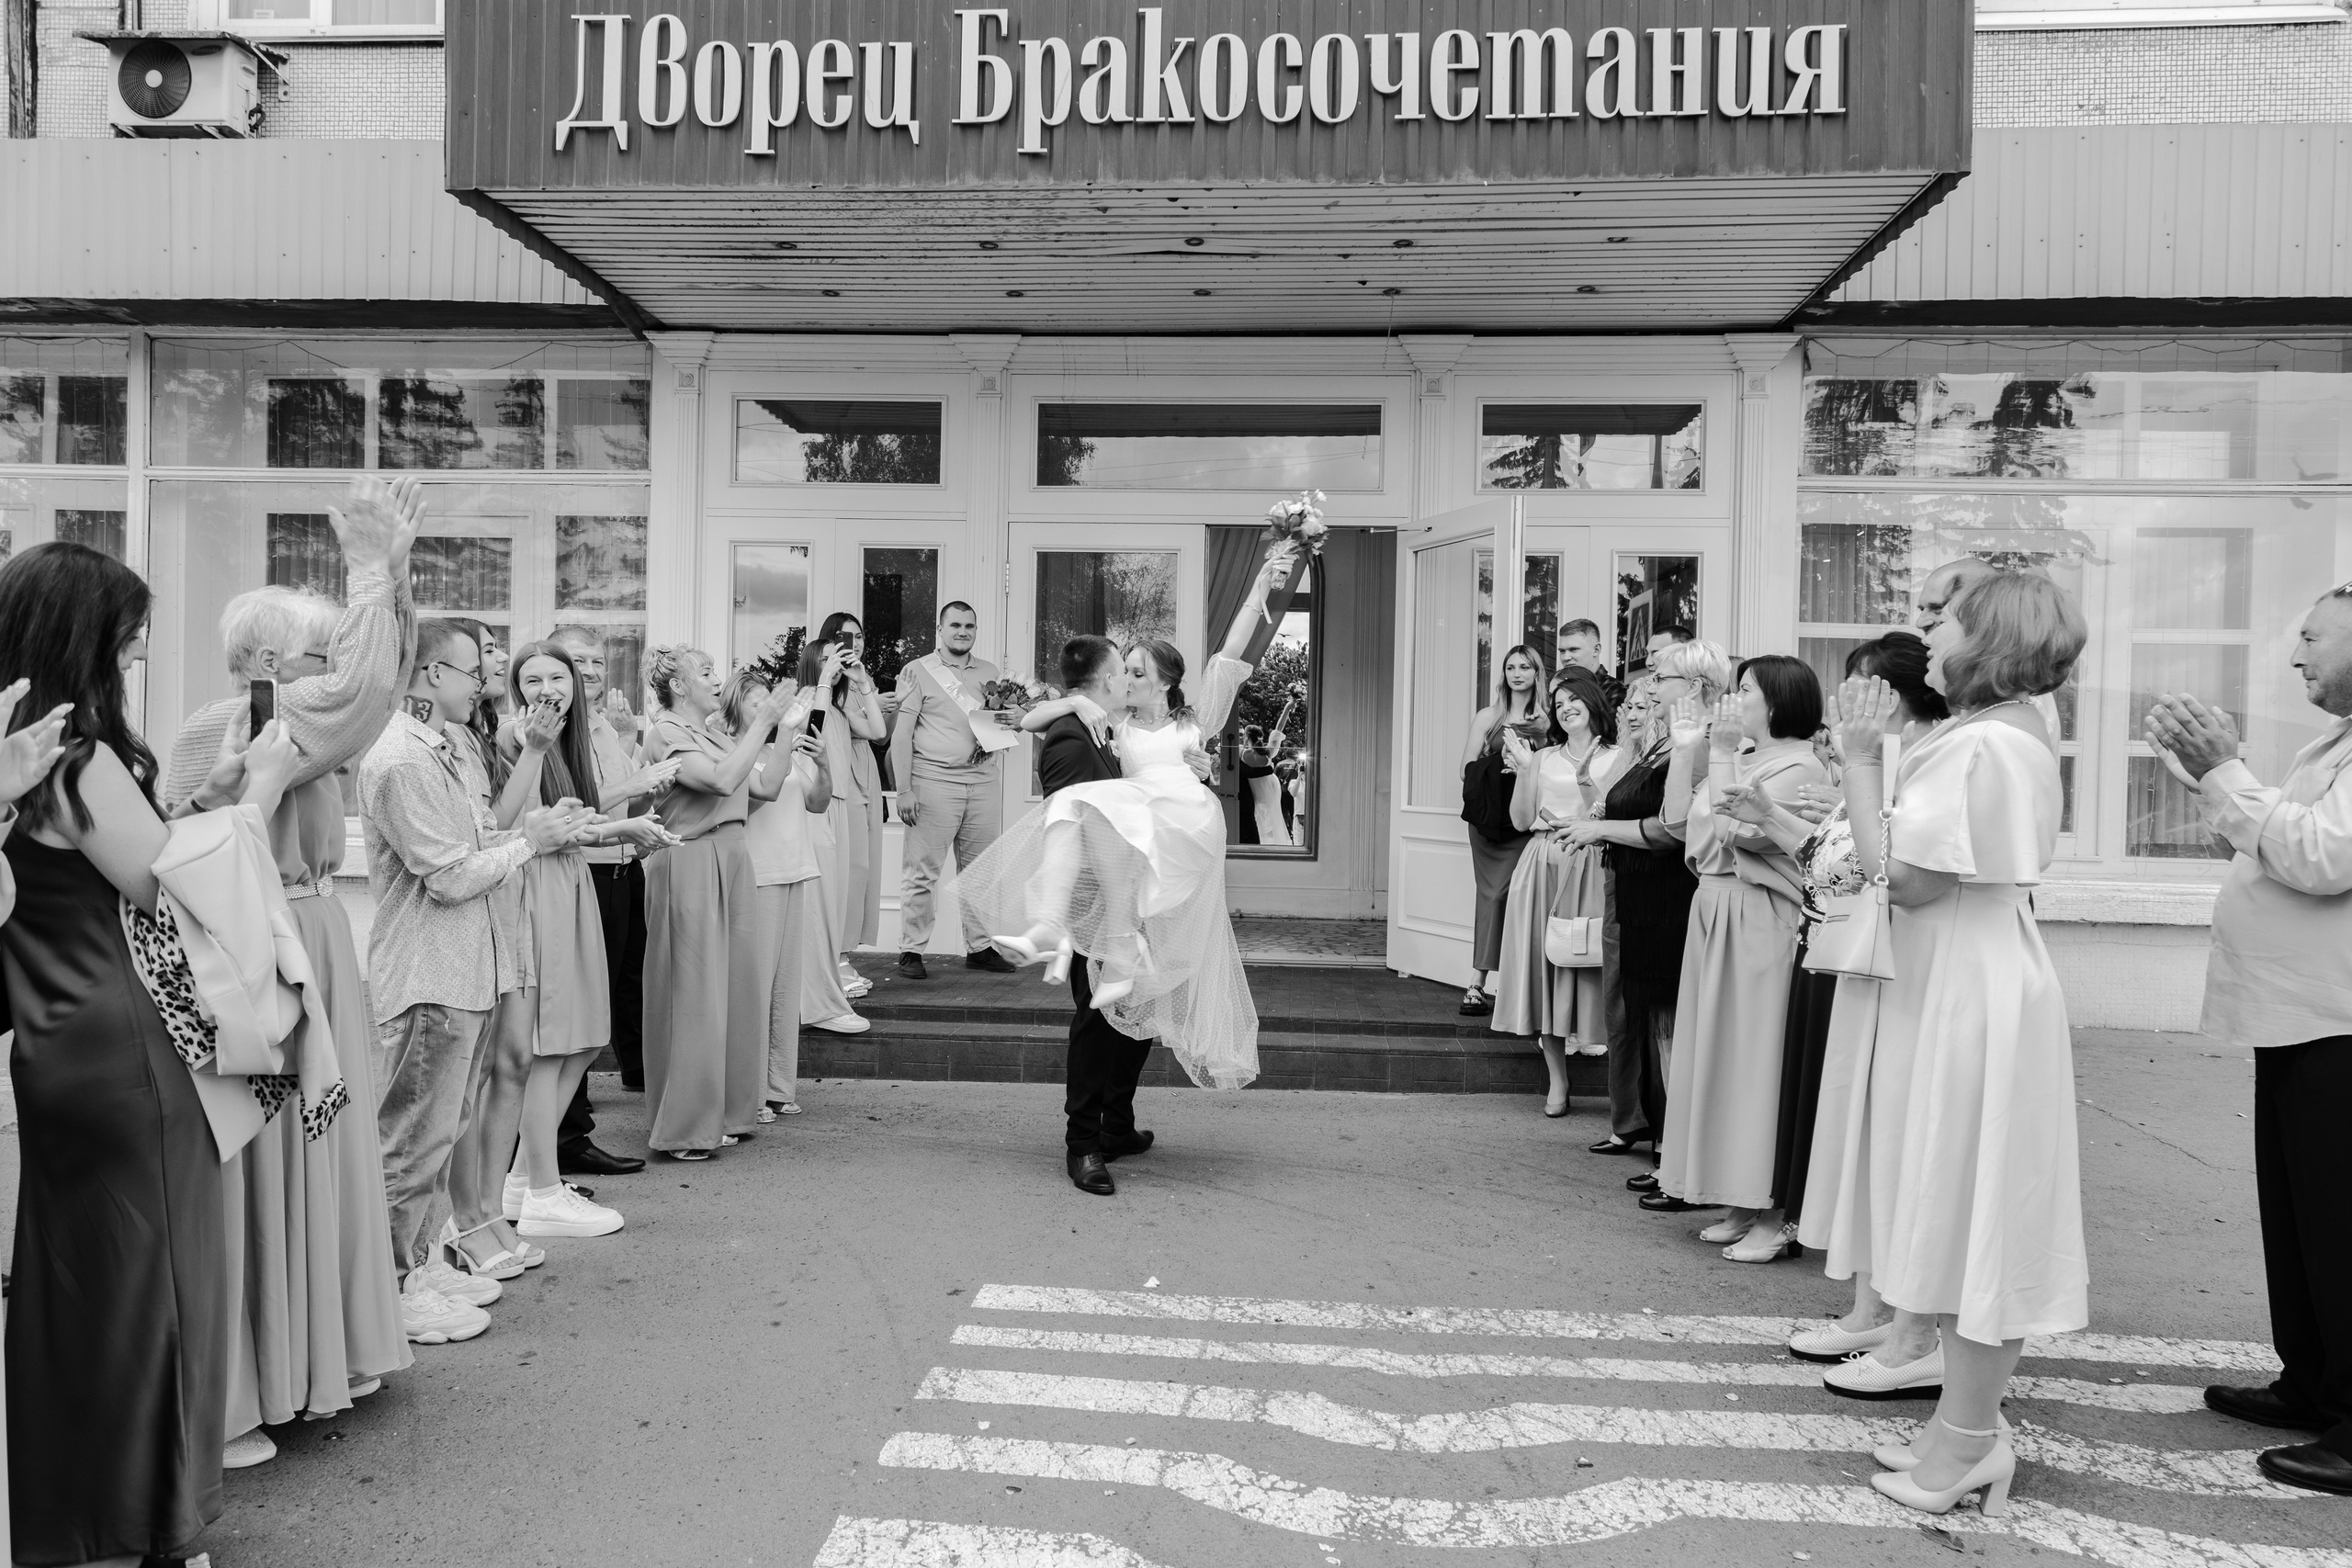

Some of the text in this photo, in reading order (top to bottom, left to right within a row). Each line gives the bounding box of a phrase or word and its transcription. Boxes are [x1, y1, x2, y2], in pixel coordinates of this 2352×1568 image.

[555, 7, 1848, 155] Дворец Бракосочетания
[405, 696, 433, 722] 13
